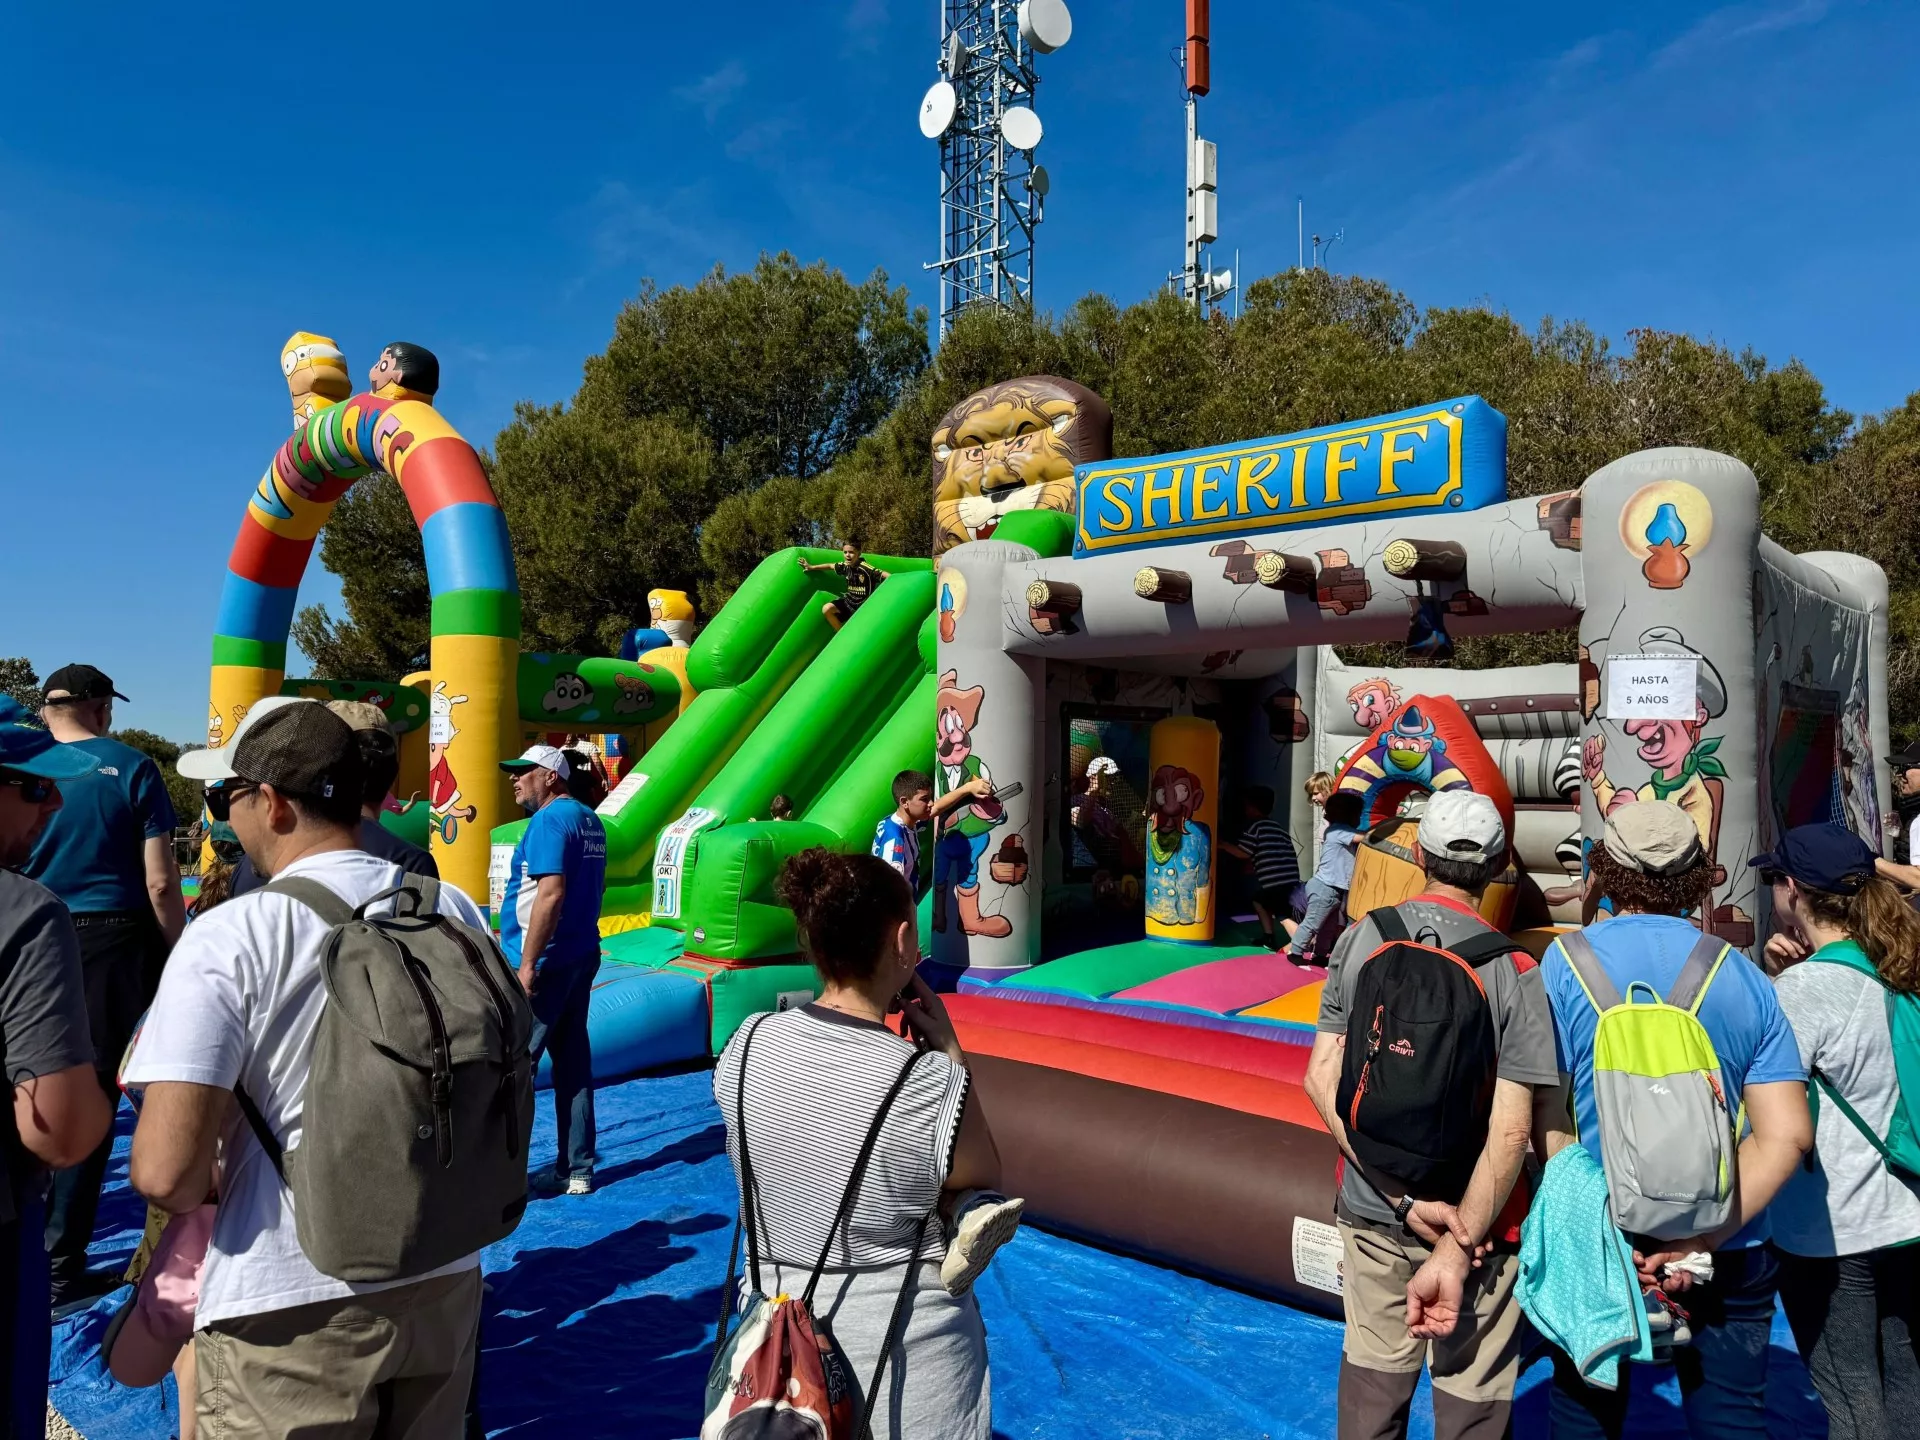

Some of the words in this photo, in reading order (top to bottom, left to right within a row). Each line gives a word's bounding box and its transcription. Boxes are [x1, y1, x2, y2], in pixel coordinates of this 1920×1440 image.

[1098, 424, 1429, 533] SHERIFF
[1631, 675, 1669, 685] HASTA
[1626, 695, 1632, 705] 5
[1637, 693, 1669, 705] AÑOS
[657, 866, 673, 877] ¡OK!
[1388, 1043, 1415, 1057] CRIVIT
